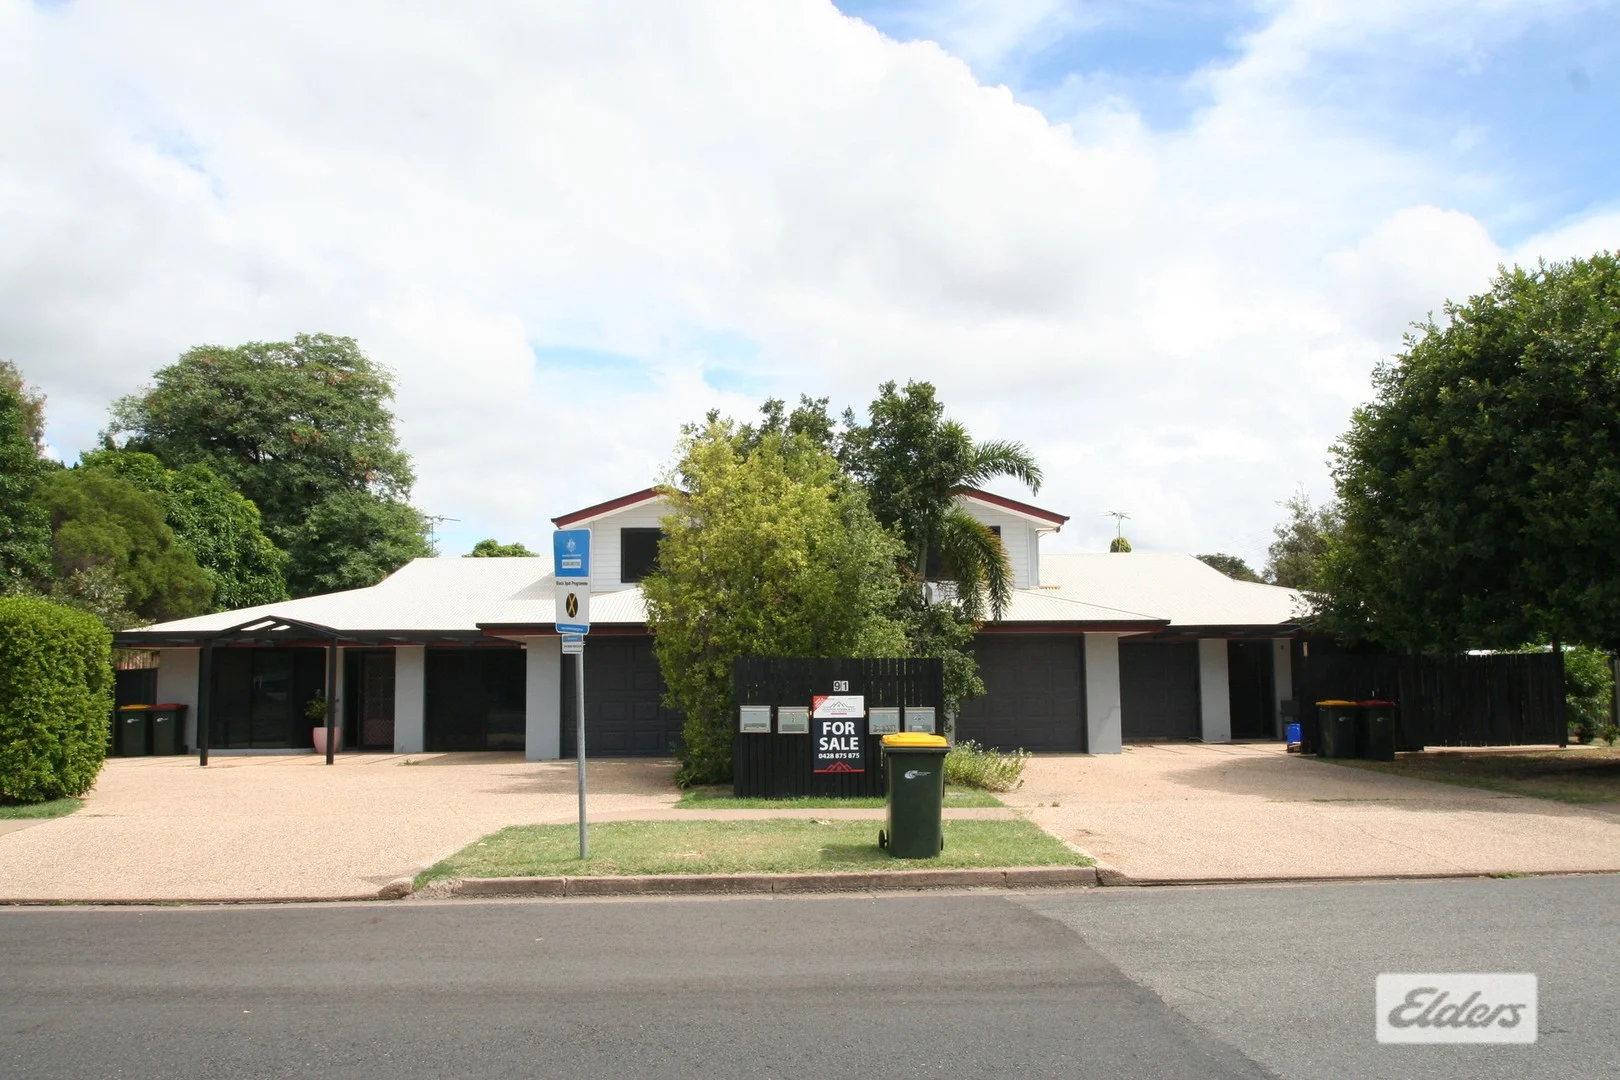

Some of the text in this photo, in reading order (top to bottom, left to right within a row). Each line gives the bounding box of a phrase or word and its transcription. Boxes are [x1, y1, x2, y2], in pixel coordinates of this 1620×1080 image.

[834, 681, 848, 691] 91
[822, 721, 855, 735] FOR
[819, 737, 859, 751] SALE
